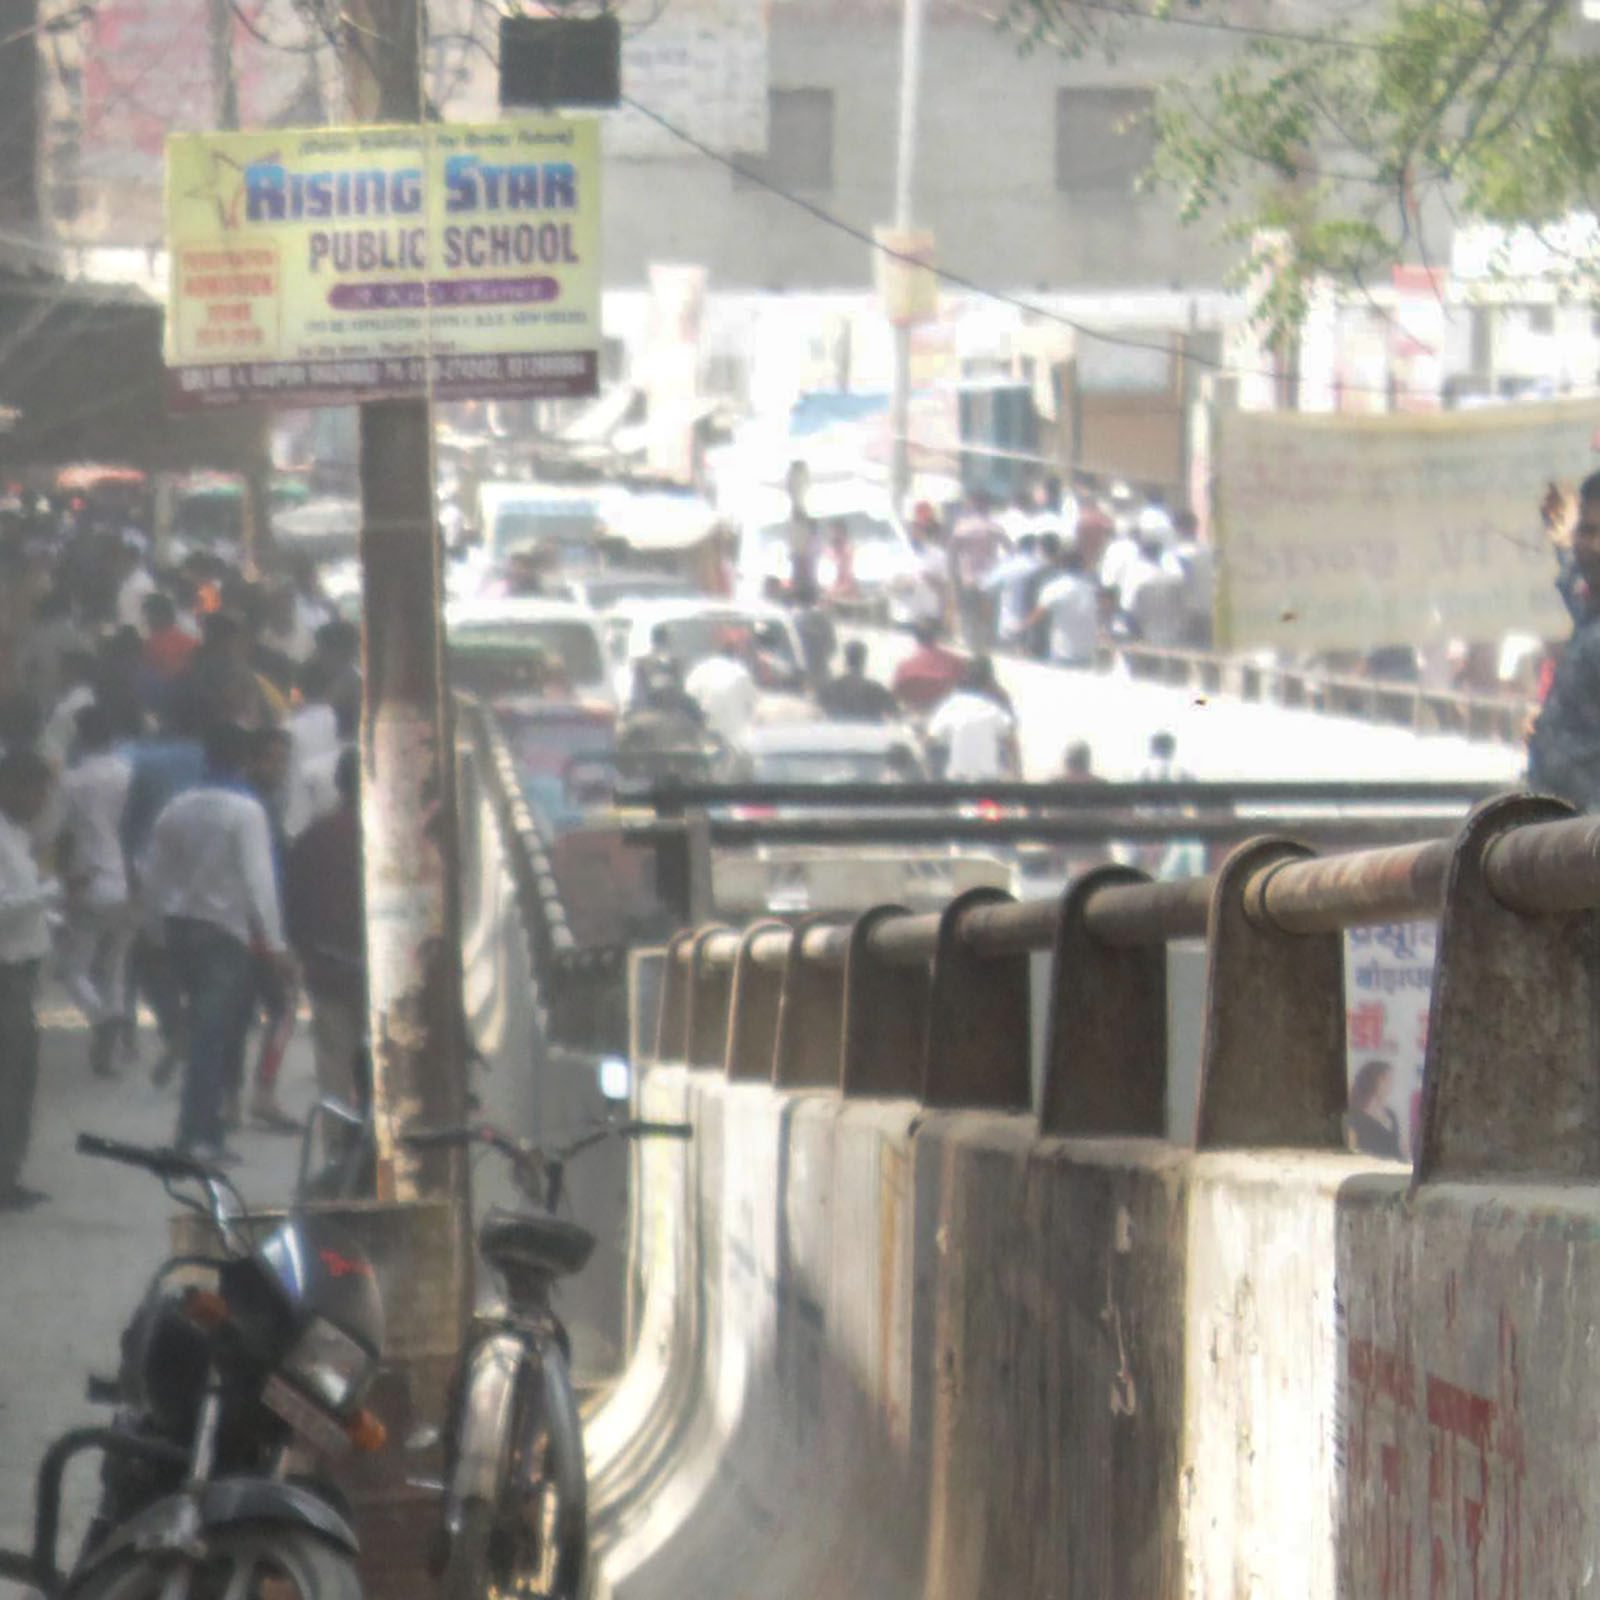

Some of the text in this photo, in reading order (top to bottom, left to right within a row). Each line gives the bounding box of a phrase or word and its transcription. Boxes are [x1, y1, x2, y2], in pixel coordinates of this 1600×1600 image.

[244, 155, 577, 221] RISING STAR
[309, 228, 427, 272] PUBLIC
[443, 224, 578, 267] SCHOOL
